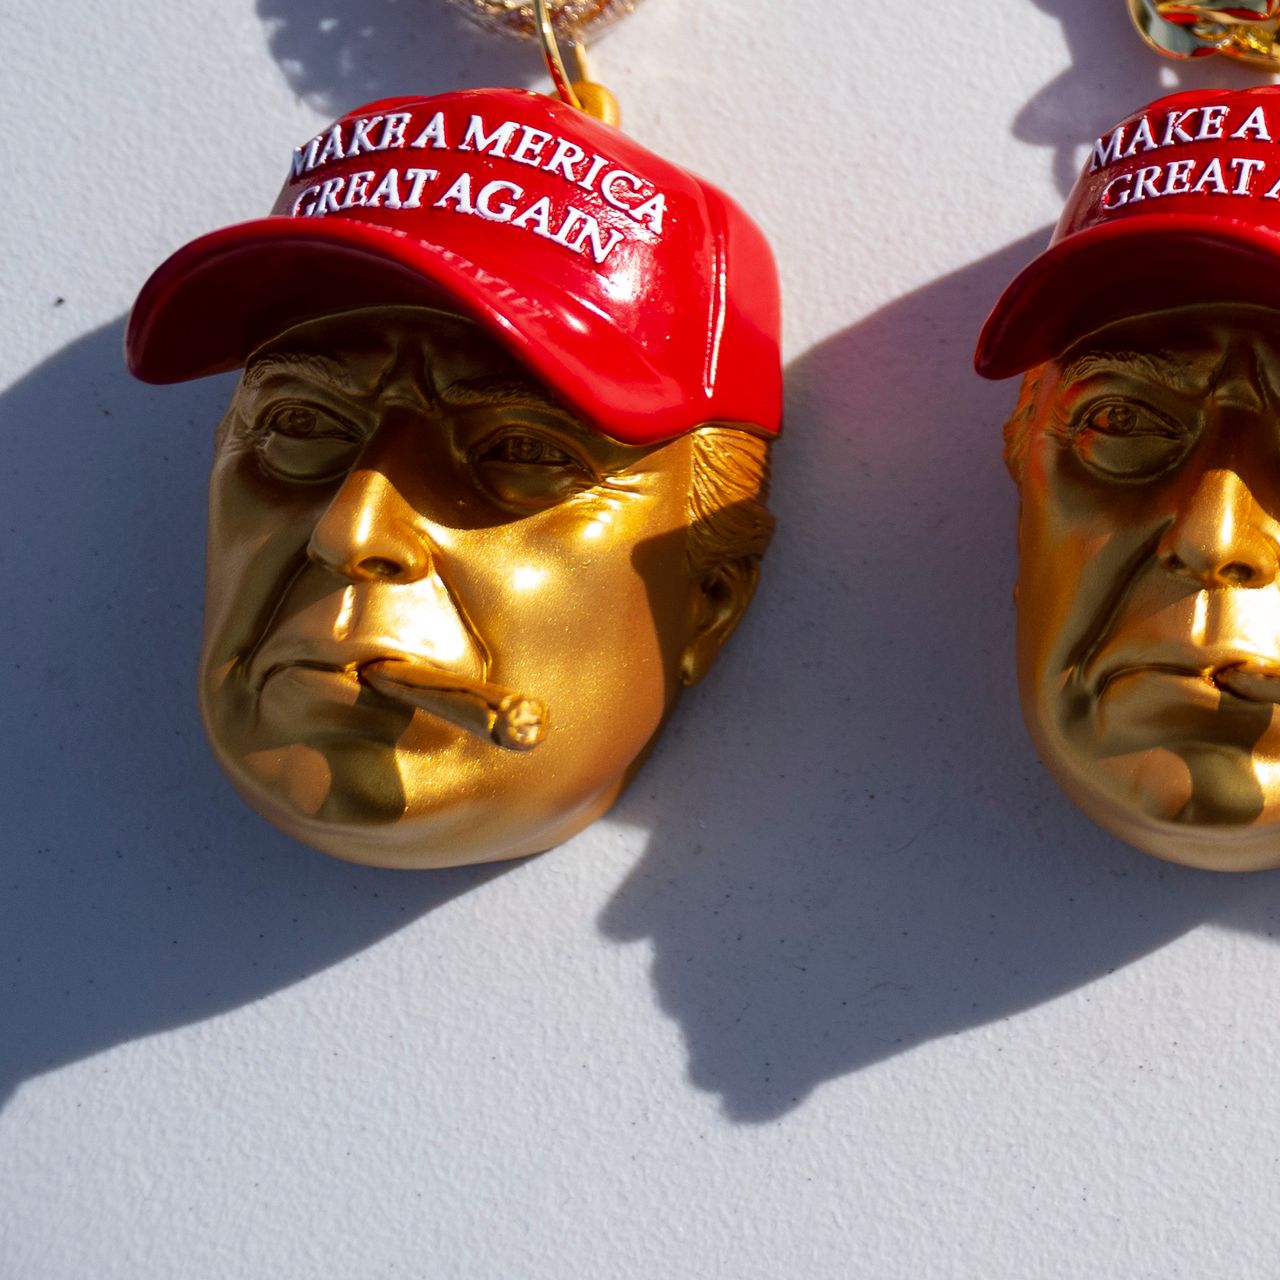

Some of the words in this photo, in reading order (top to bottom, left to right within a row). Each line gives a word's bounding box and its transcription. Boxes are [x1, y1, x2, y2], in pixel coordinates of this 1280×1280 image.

[291, 112, 411, 177] MAKE
[1088, 105, 1230, 172] MAKE
[292, 168, 440, 217] GREAT
[440, 172, 624, 264] AGAIN
[1101, 157, 1264, 210] GREAT
